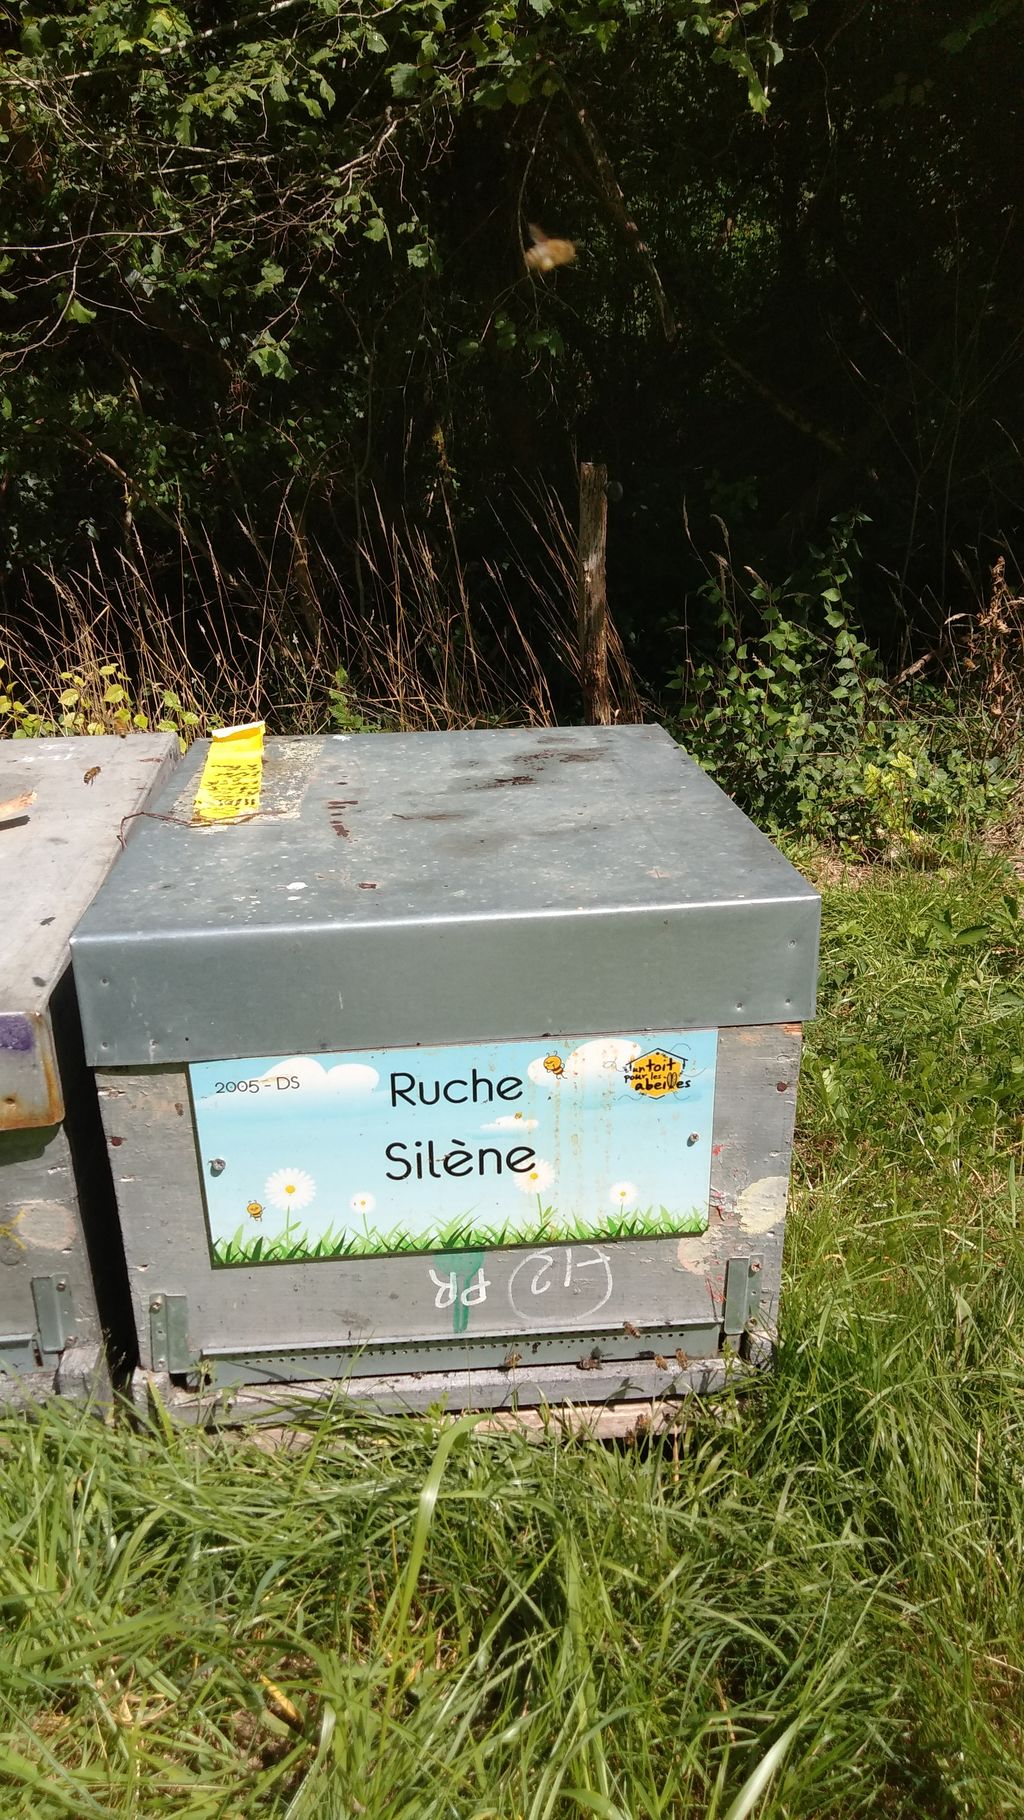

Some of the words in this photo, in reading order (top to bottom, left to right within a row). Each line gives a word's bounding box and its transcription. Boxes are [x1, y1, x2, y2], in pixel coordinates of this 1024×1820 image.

[646, 1057, 676, 1072] toit
[214, 1080, 260, 1094] 2005
[276, 1075, 300, 1090] DS
[390, 1068, 524, 1107] Ruche
[623, 1073, 647, 1084] pour
[650, 1072, 662, 1080] les
[634, 1072, 692, 1091] abeilles
[385, 1138, 537, 1181] Silène
